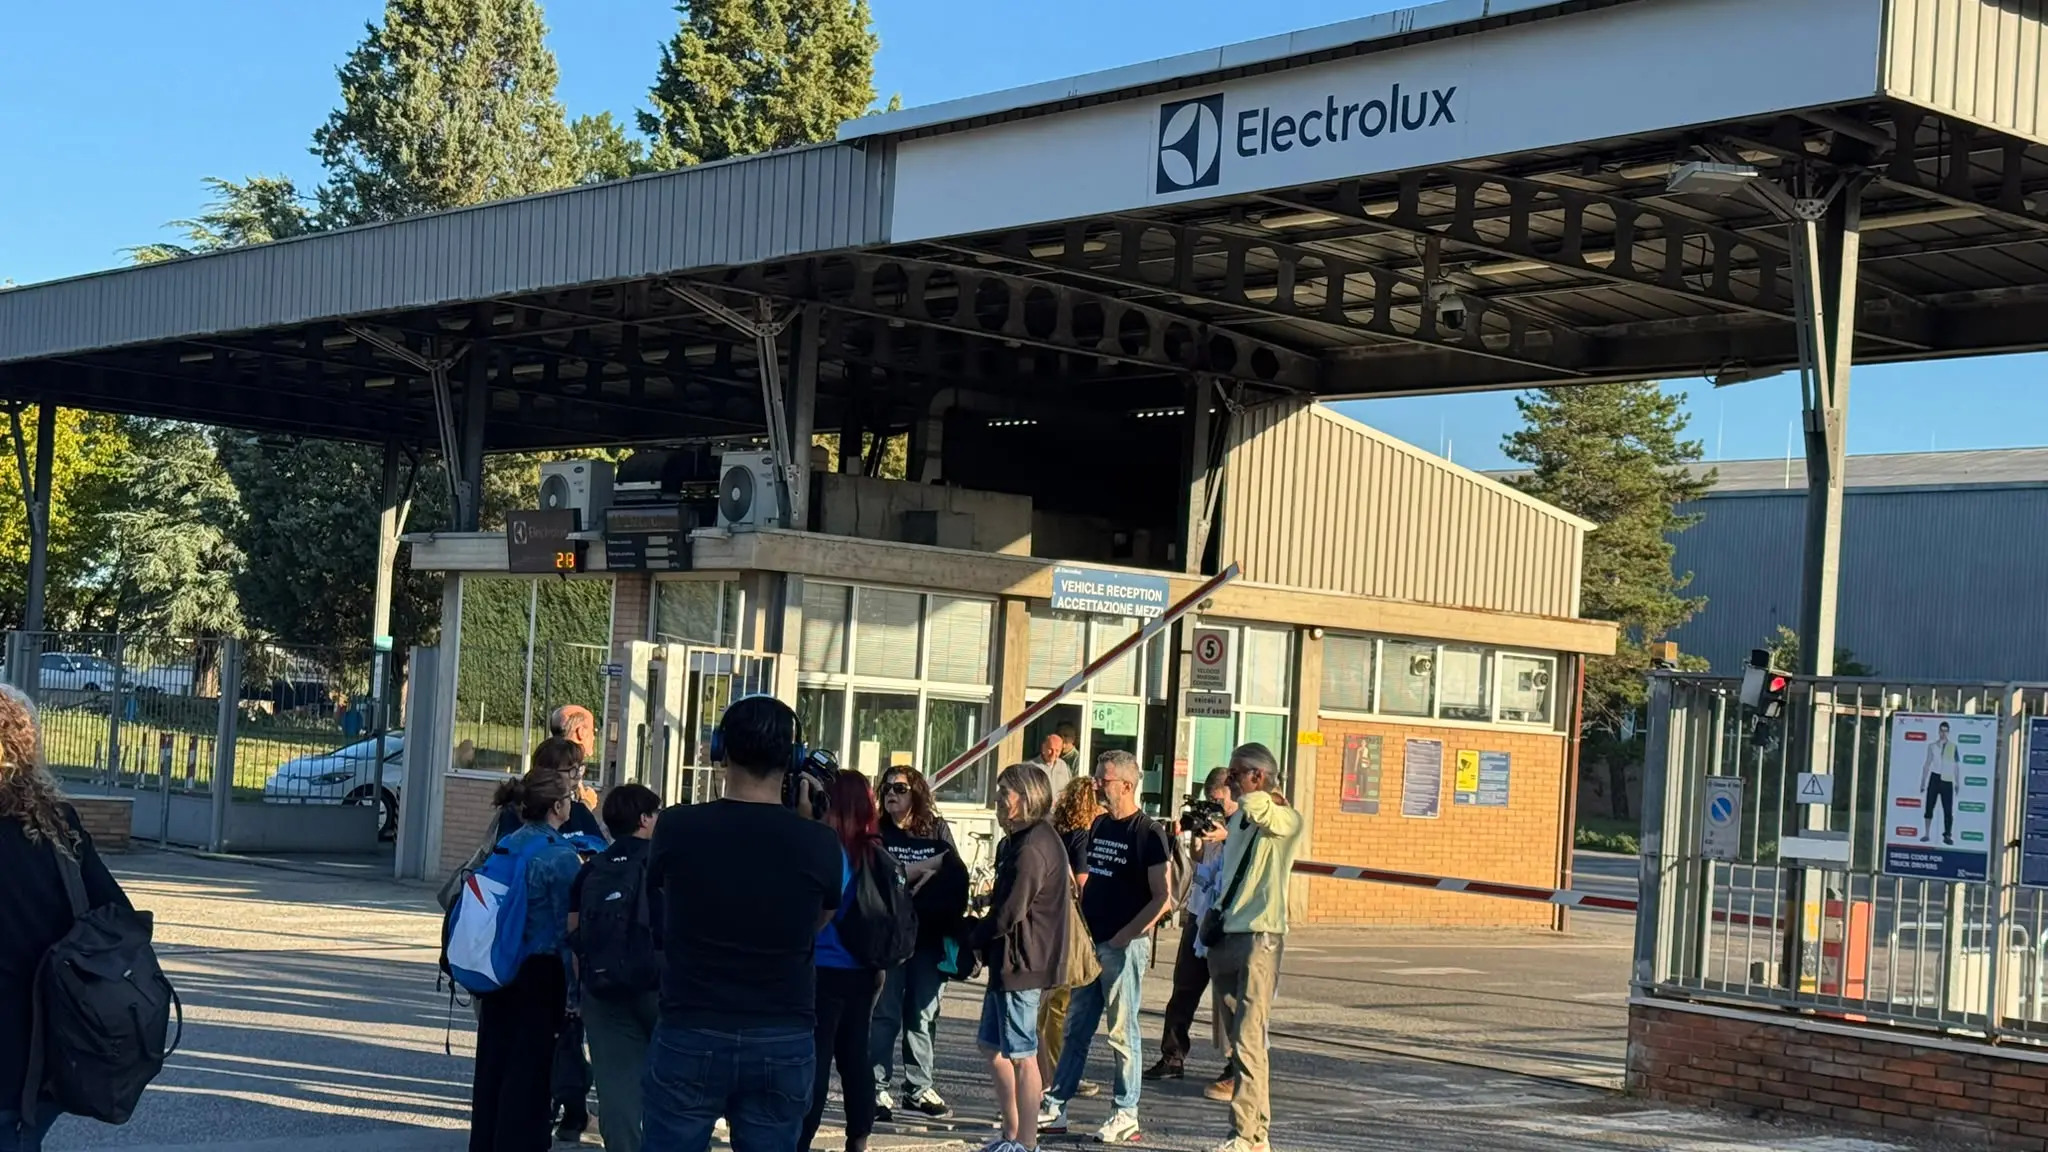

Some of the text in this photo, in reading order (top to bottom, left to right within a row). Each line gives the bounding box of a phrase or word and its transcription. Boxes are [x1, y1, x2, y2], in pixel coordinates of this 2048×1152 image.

[1236, 83, 1457, 157] Electrolux
[1061, 580, 1162, 602] VEHICLE RECEPTION
[1057, 596, 1134, 615] ACCETTAZIONE
[1205, 640, 1215, 659] 5
[1093, 709, 1105, 721] 16
[1910, 853, 1929, 861] CODE
